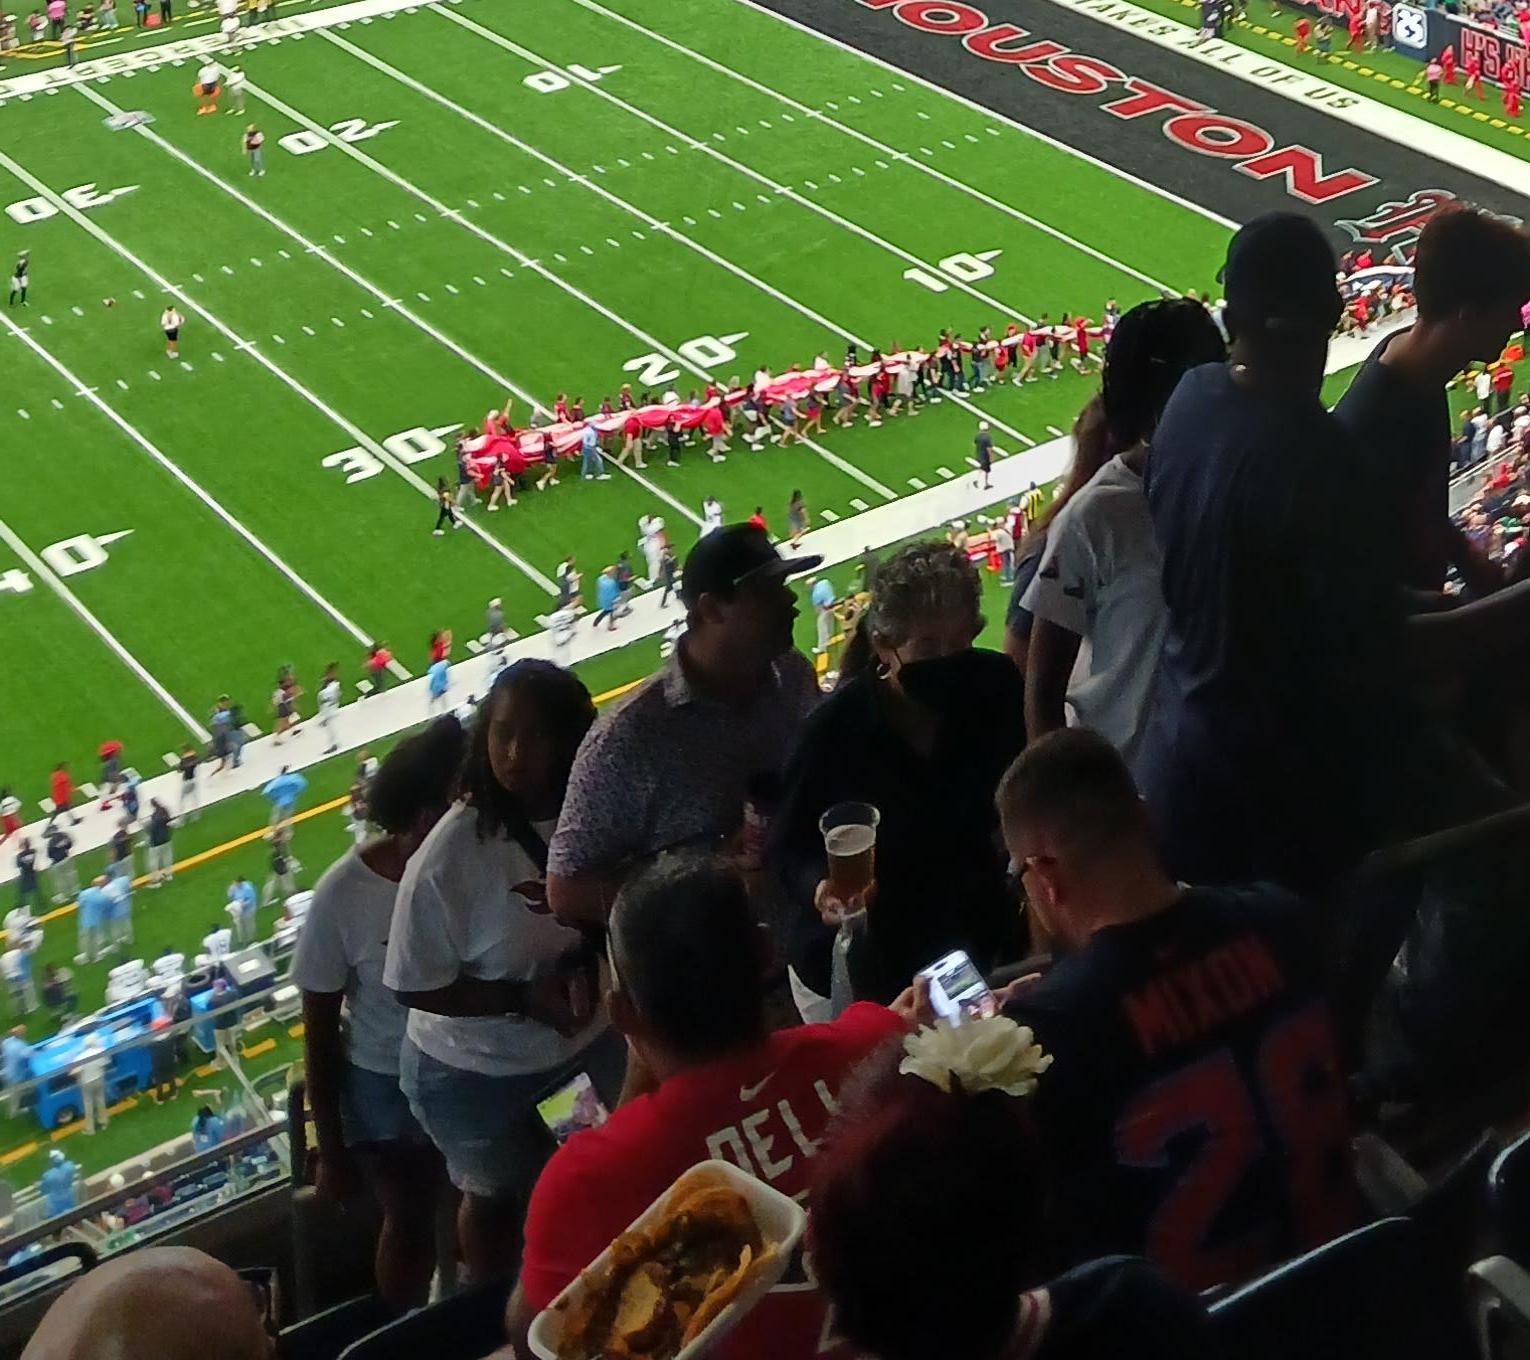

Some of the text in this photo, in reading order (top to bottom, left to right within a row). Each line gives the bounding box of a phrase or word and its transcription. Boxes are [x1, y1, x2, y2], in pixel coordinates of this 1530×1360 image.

[522, 63, 603, 94] 10
[1249, 65, 1305, 86] OF
[1303, 86, 1363, 109] US
[277, 118, 377, 157] 20
[4, 183, 118, 225] 30
[903, 251, 995, 294] 10
[622, 336, 737, 388] 20
[321, 425, 447, 485] 30
[1122, 932, 1287, 1057] MIXON
